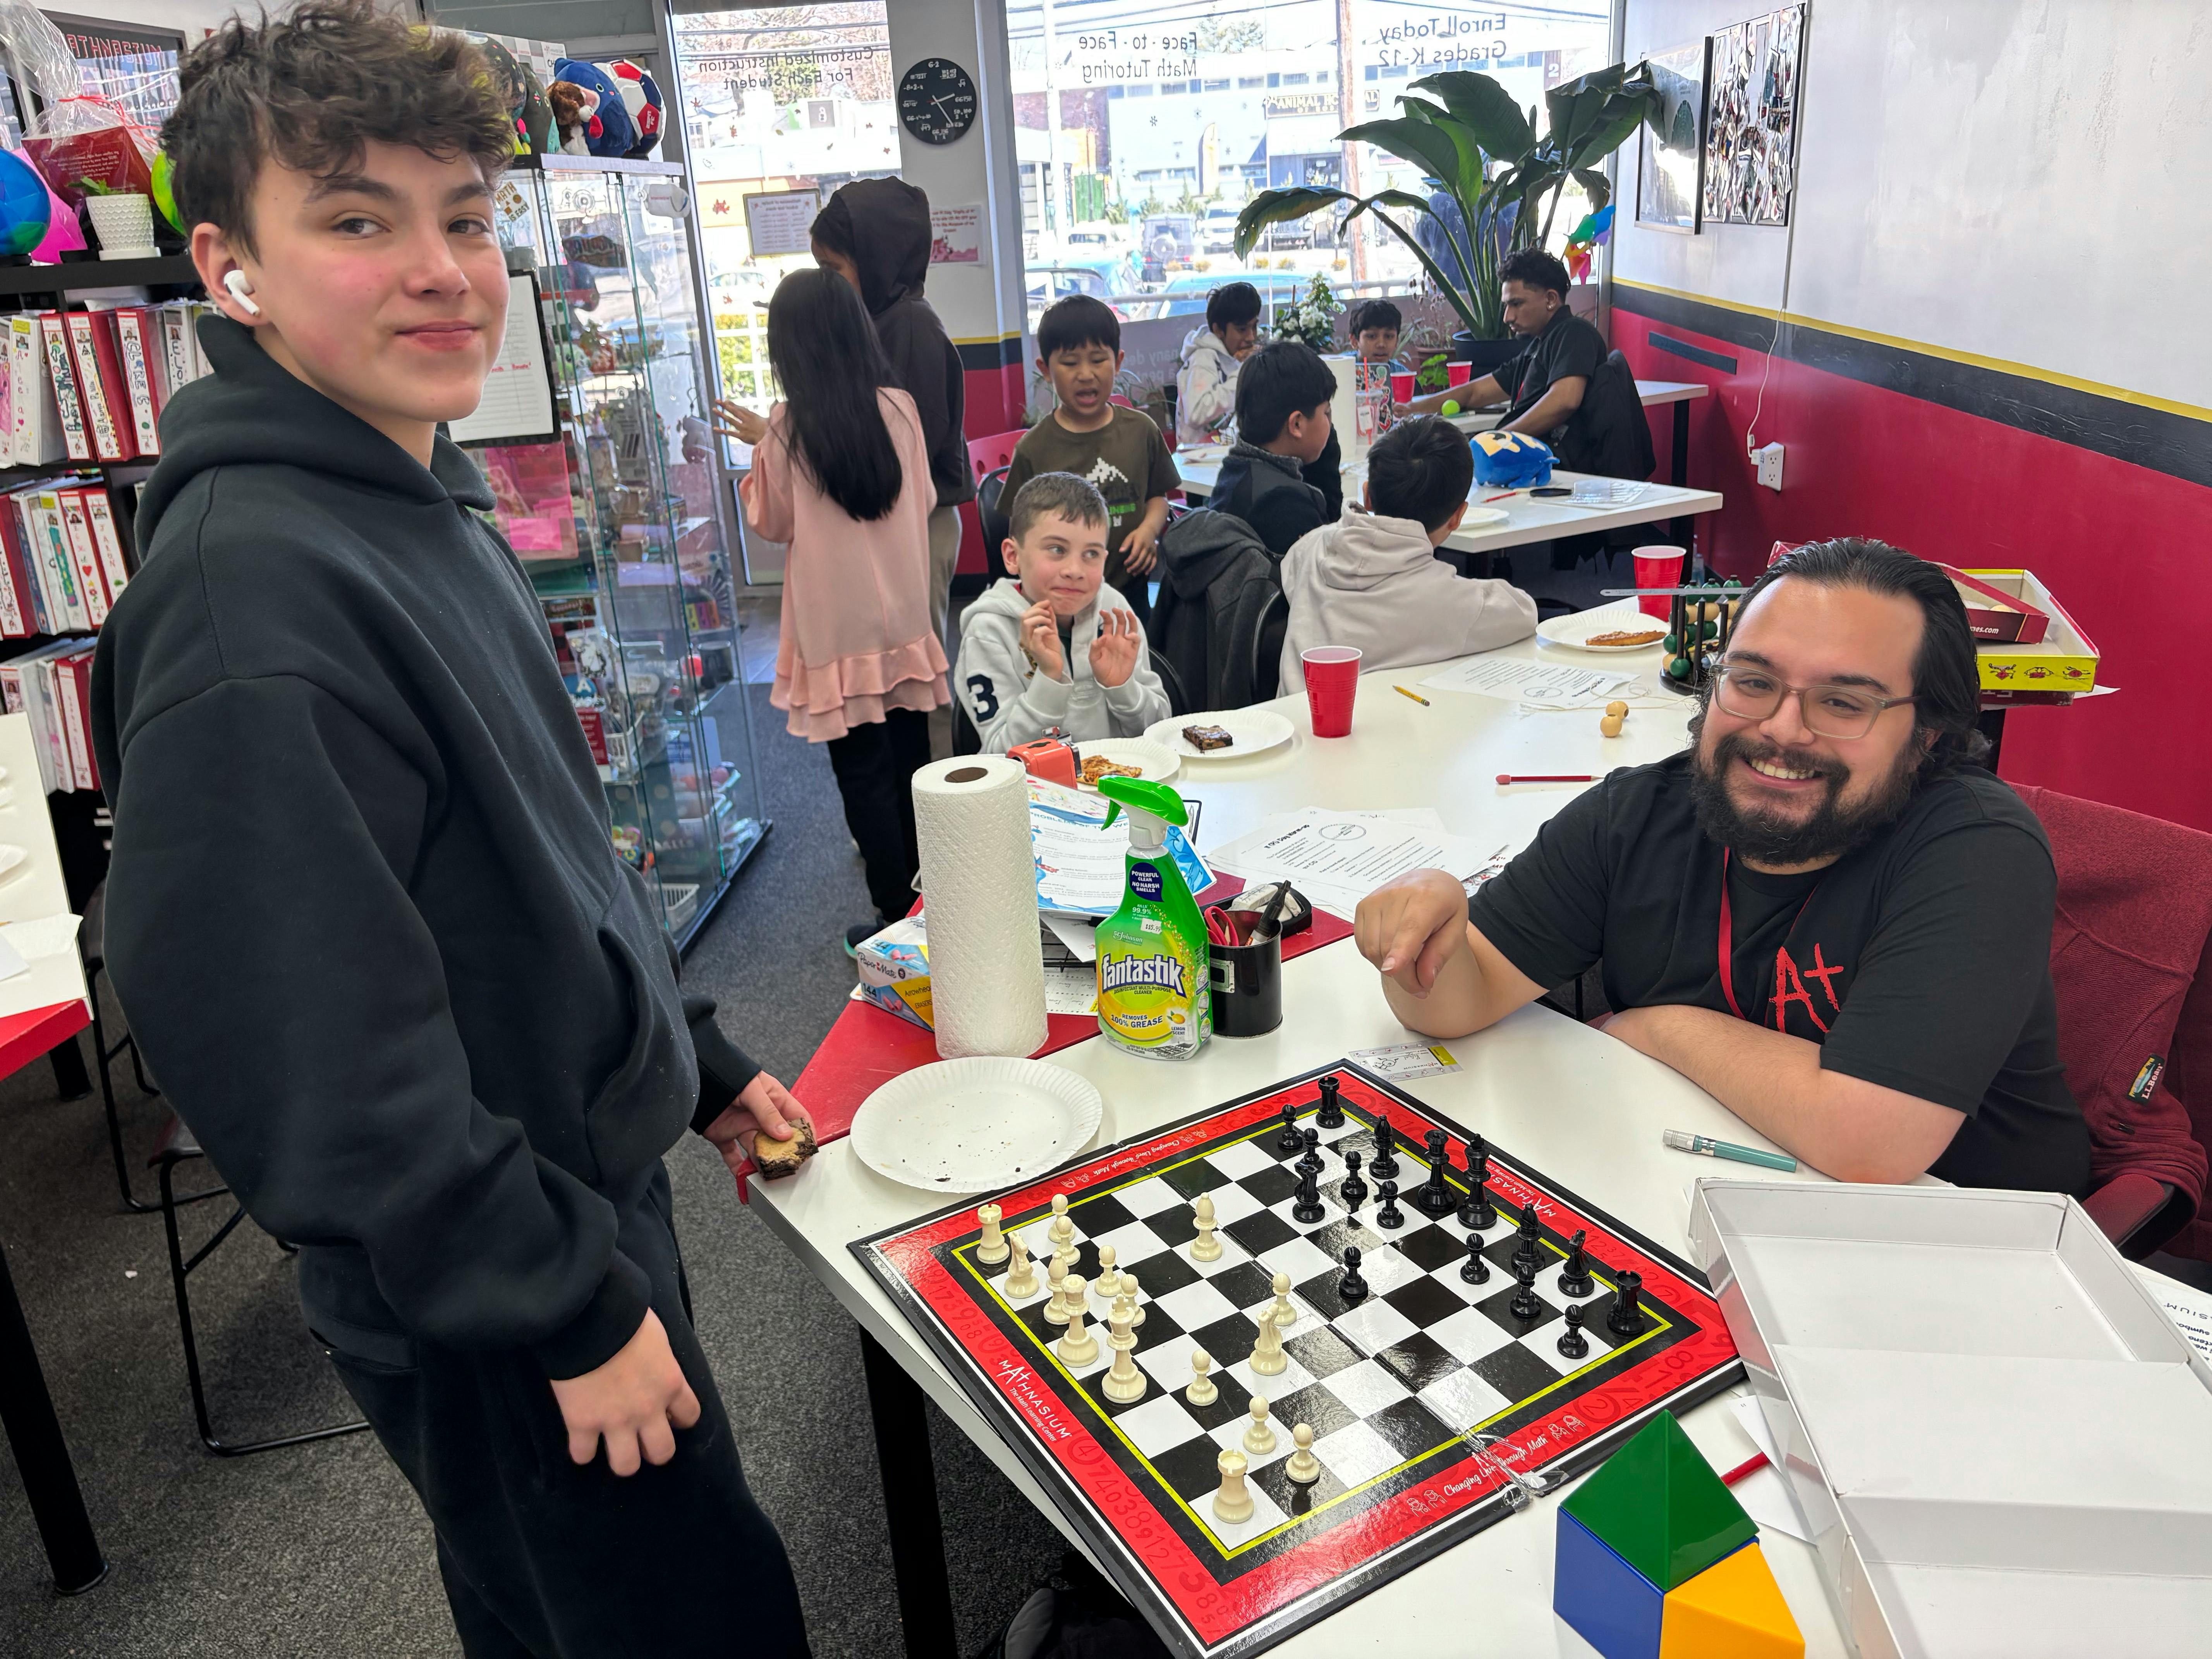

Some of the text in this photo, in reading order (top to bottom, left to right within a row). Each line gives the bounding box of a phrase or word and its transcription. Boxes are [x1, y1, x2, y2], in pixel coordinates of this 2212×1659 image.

[66, 34, 163, 65] ATHNASIUM
[1277, 95, 1320, 109] ANIMAL
[495, 181, 517, 204] MATH
[515, 202, 530, 218] EASY
[967, 674, 999, 723] 3
[858, 952, 897, 978] Paper Mate
[1102, 954, 1185, 997] fantastik
[863, 983, 877, 997] 144
[905, 986, 931, 996] Arrowhea
[1114, 986, 1138, 994] DISINFECTANT
[1111, 1015, 1163, 1028] 100% GREASE
[1093, 1140, 1180, 1176] Changing Lives Through Math
[1494, 1168, 1515, 1182] Learning
[1513, 1182, 1527, 1190] Math
[2176, 1322, 2210, 1336] symbo
[996, 1359, 1072, 1438] MATHNASIUM
[1009, 1387, 1057, 1441] The Math Learning Center
[1444, 1474, 1482, 1496] Changing
[1497, 1447, 1528, 1465] hrough
[1526, 1435, 1548, 1455] Math
